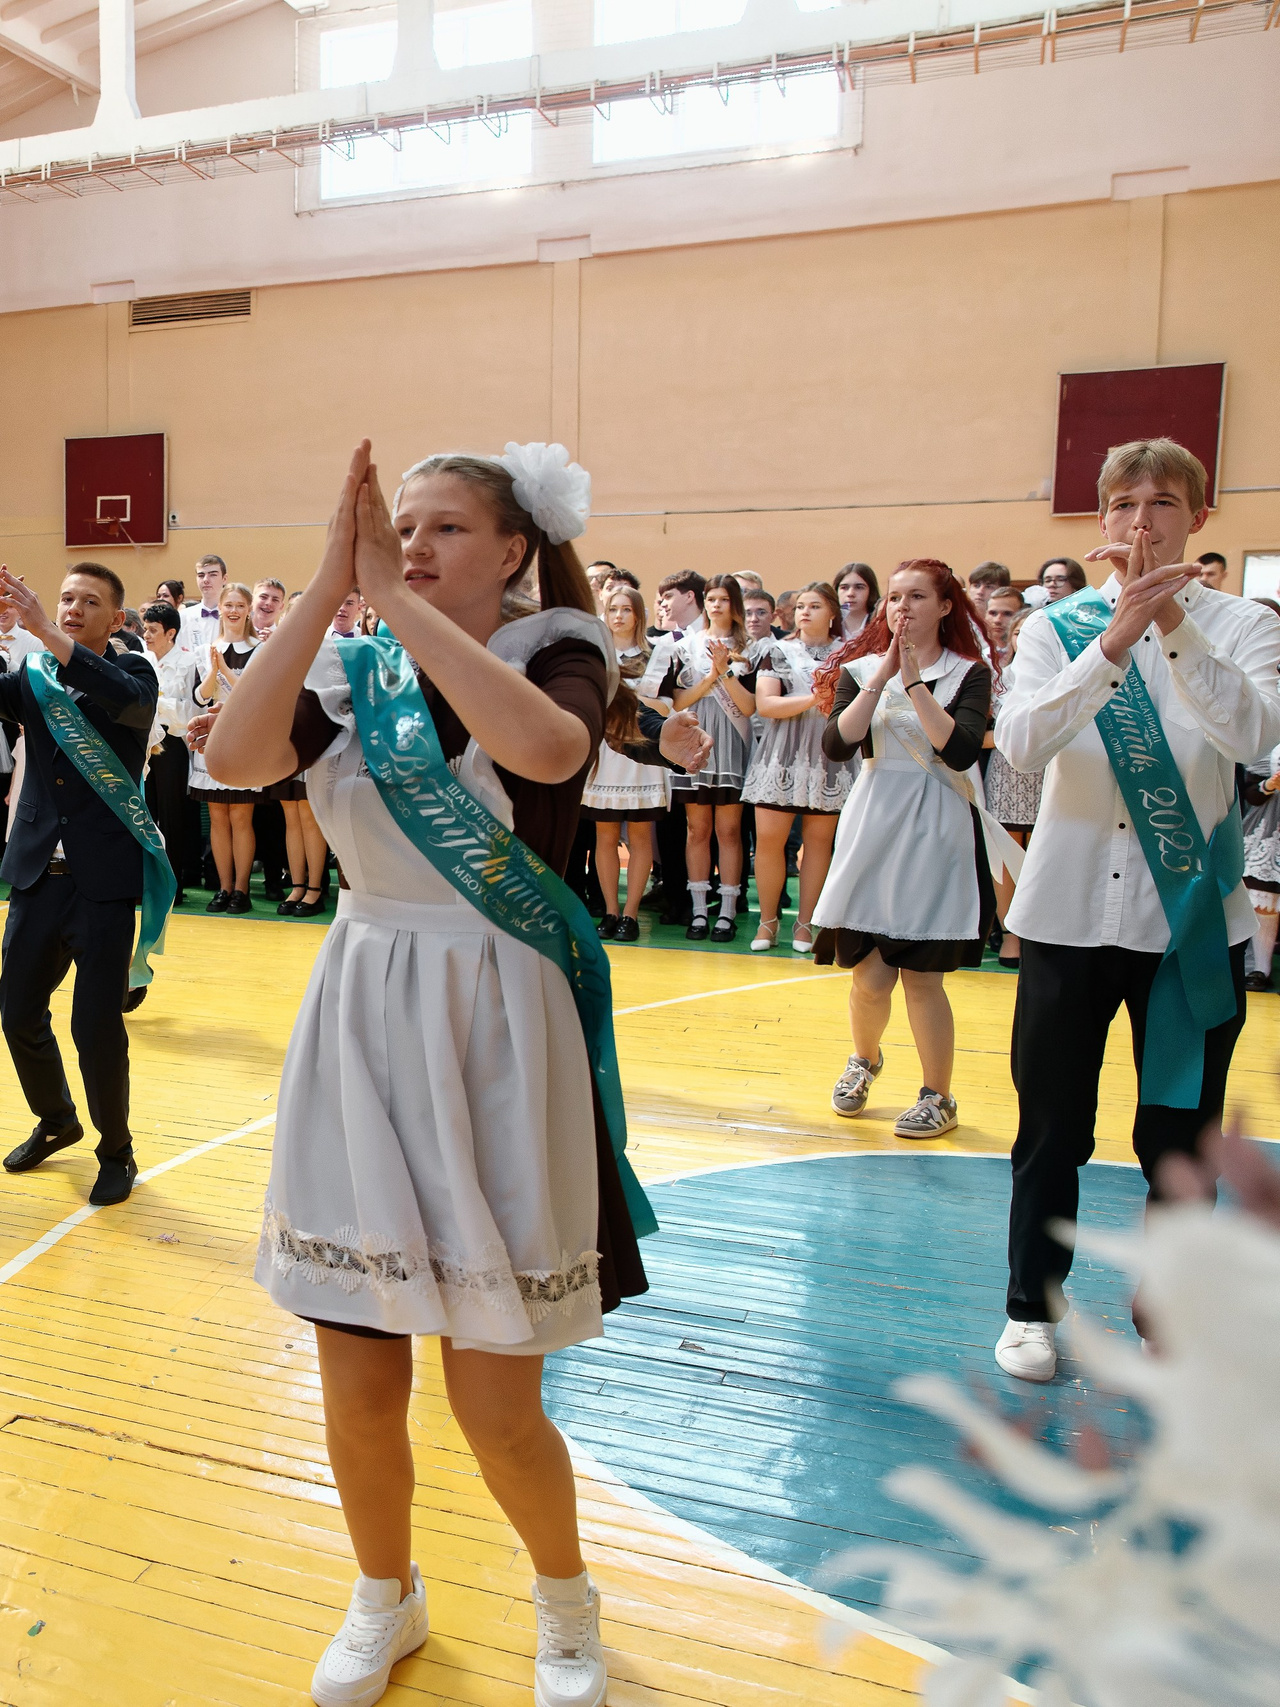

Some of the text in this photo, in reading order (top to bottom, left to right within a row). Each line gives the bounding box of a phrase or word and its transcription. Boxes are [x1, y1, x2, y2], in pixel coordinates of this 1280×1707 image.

[387, 735, 562, 935] Выпускница
[445, 781, 546, 877] ШАТУНОВА СОФИЯ
[1138, 787, 1205, 873] 2025
[450, 863, 485, 897] МБОУ
